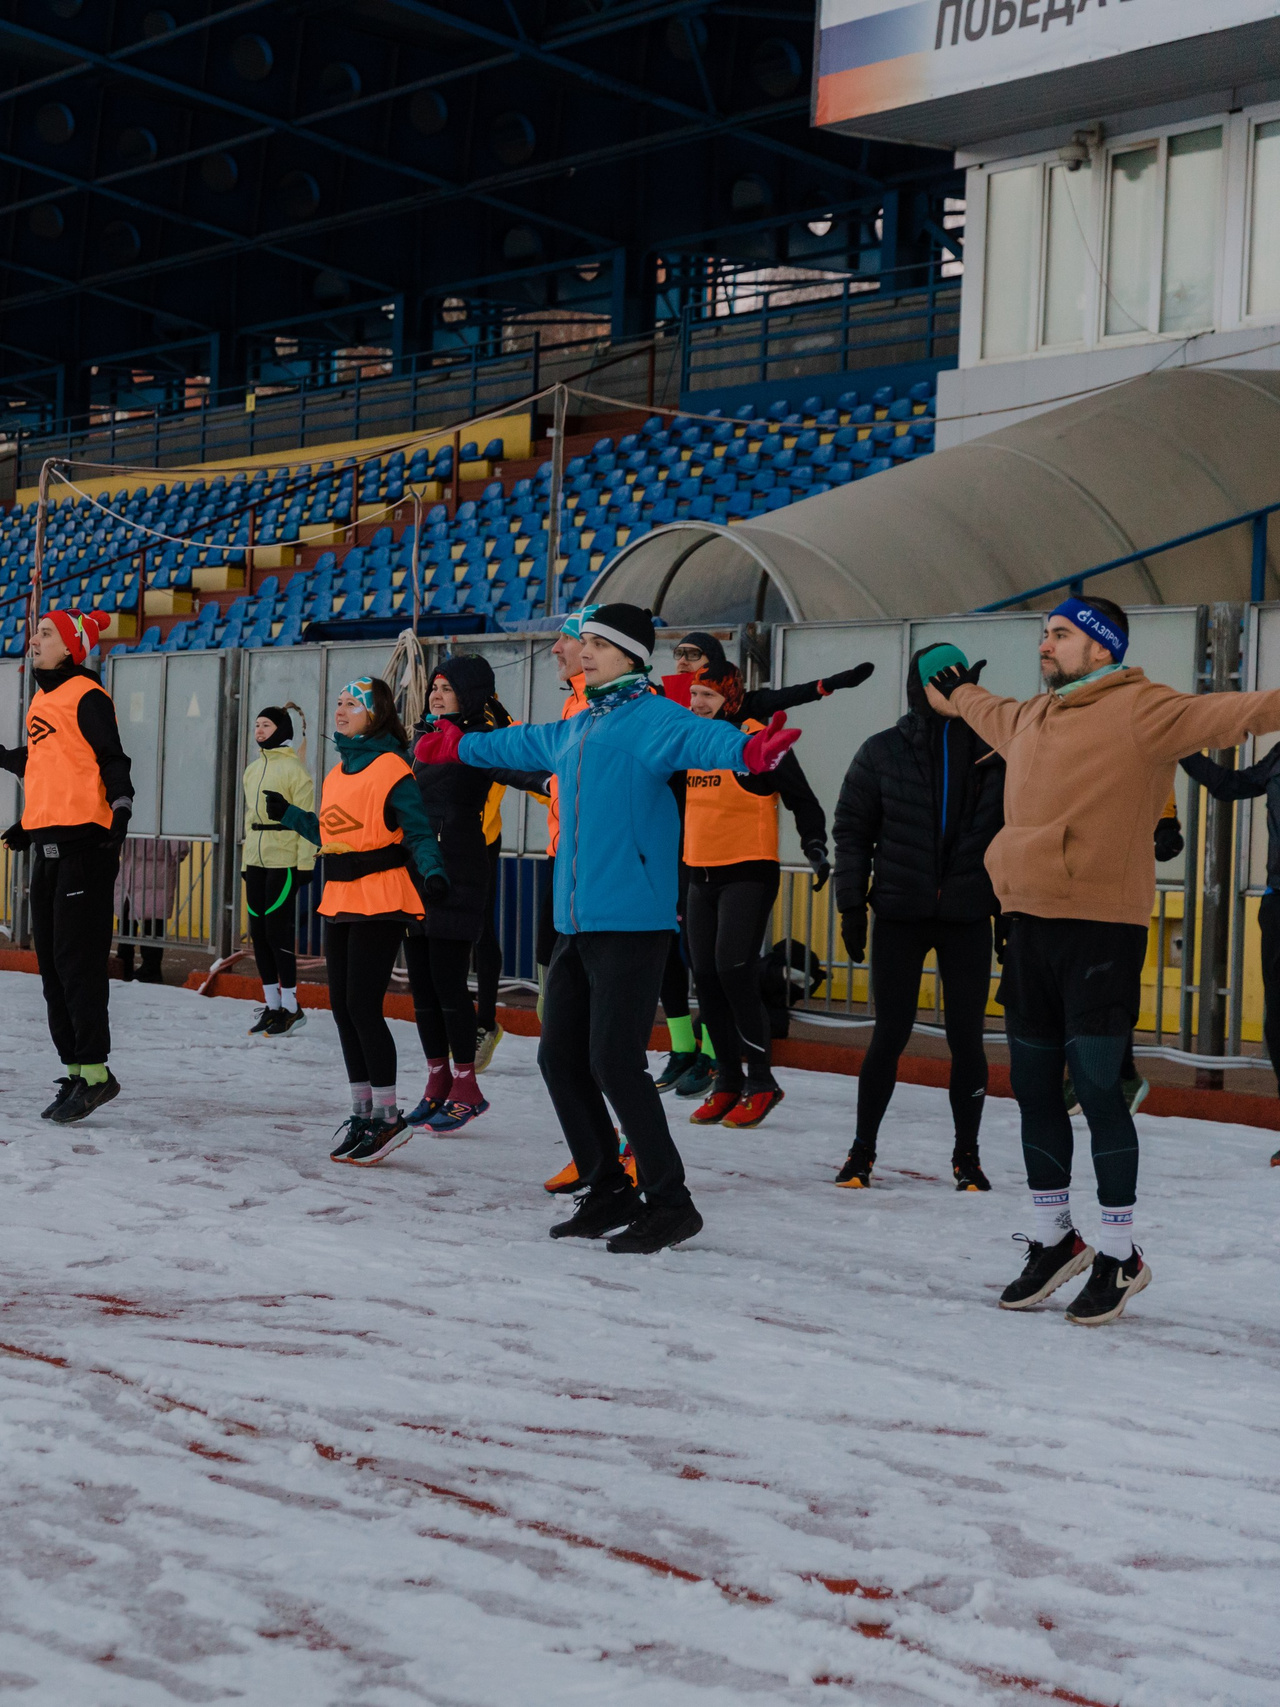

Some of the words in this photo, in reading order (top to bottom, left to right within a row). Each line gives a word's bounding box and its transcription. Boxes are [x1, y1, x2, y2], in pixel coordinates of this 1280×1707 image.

[934, 0, 1107, 50] ПОБЕД
[1086, 616, 1123, 650] ГАЗПРОМ
[1033, 1194, 1068, 1203] AMILY
